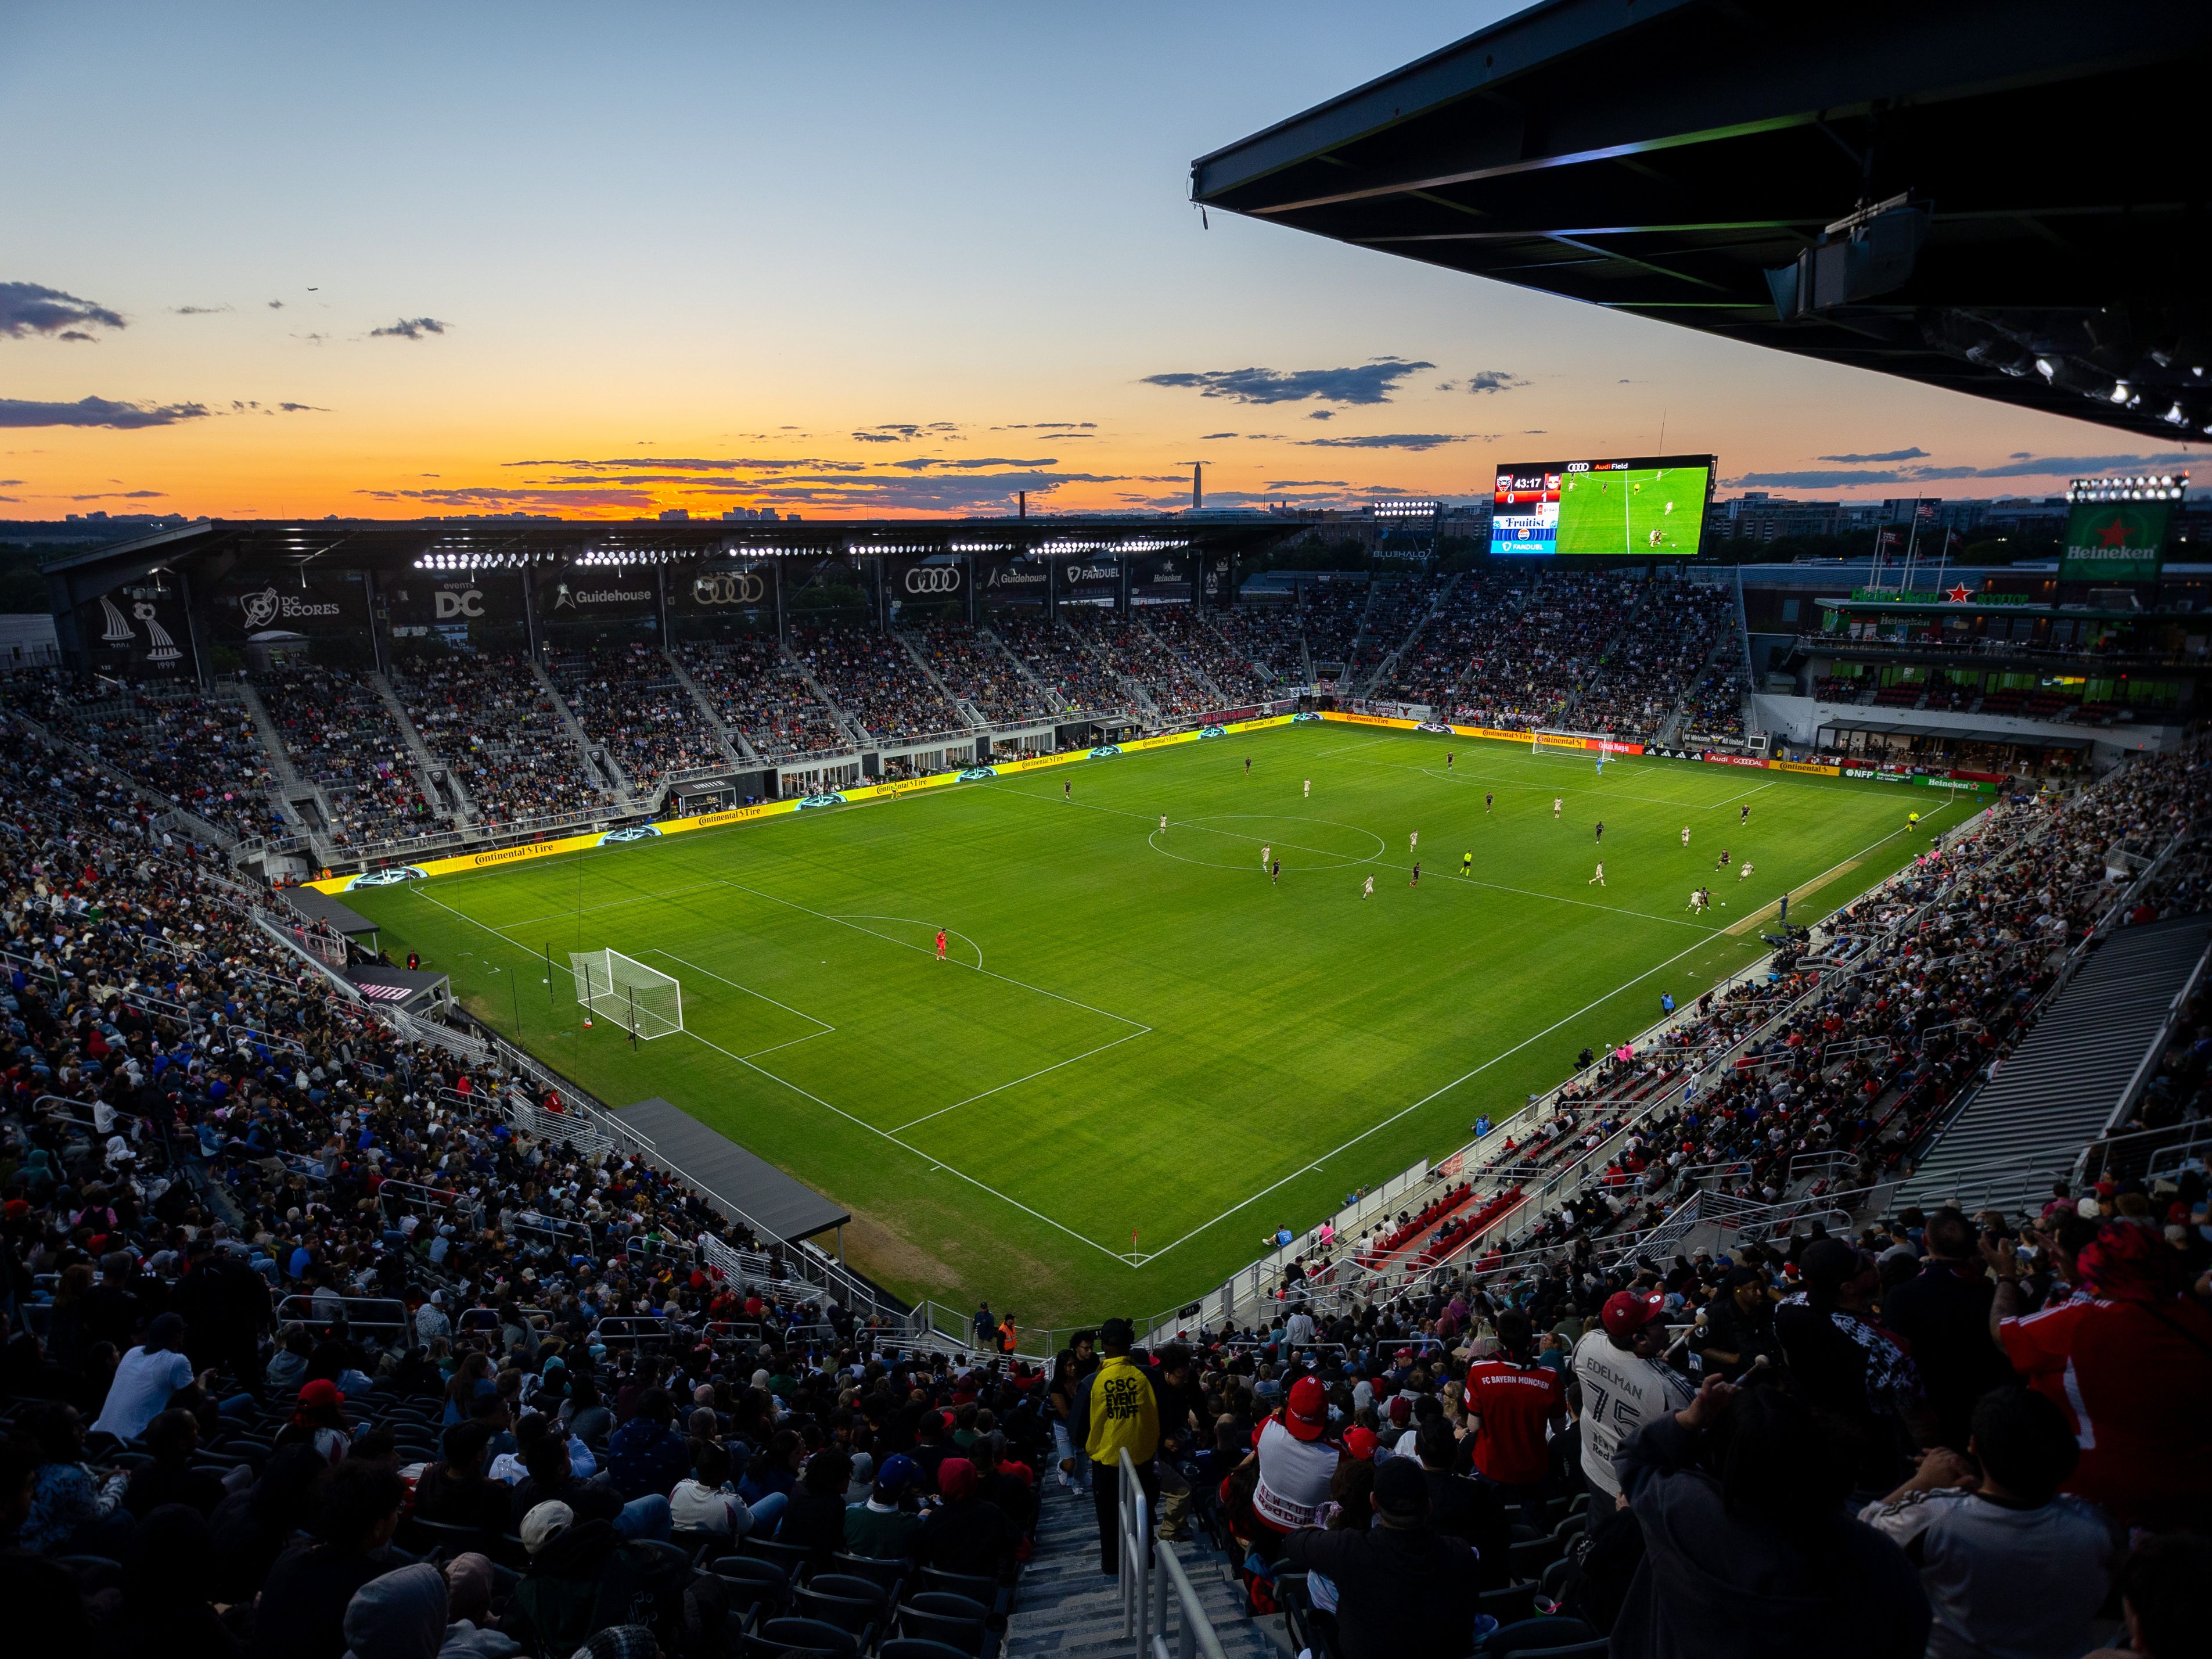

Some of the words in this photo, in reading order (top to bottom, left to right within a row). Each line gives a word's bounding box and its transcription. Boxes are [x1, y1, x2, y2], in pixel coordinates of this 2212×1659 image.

[1515, 478, 1542, 488] 43:17
[1508, 493, 1515, 504] 0
[1542, 492, 1547, 502] 1
[1505, 518, 1545, 527] Fruitist
[1373, 550, 1426, 558] BLUEHALO
[2066, 545, 2155, 559] Heineken
[1001, 573, 1047, 584] Guidehouse
[1082, 567, 1120, 580] FANDUEL
[1153, 573, 1182, 583] Heineken
[444, 581, 475, 590] events
[281, 596, 300, 606] DC
[576, 589, 652, 604] Guidehouse
[1851, 588, 1940, 604] Heineken
[1976, 594, 2030, 605] ROOFTOP
[282, 604, 340, 617] SCORES
[434, 590, 485, 619] DC
[1880, 616, 1932, 627] Heineken
[157, 661, 177, 670] 1999
[1347, 714, 1373, 723] Continental
[1245, 720, 1264, 730] Continental
[1482, 728, 1513, 739] Continental
[1143, 736, 1166, 748] Continental
[1691, 734, 1711, 743] Welcome
[1729, 738, 1744, 746] United
[1022, 757, 1051, 769] Continental
[1053, 755, 1064, 763] Tire
[1779, 762, 1821, 773] Continental
[1854, 770, 1873, 779] NFP
[692, 780, 725, 789] UNITED
[877, 782, 909, 795] Contintal
[913, 778, 927, 787] Tire
[1928, 778, 1969, 790] Heineken
[699, 810, 739, 826] Continental
[743, 807, 761, 817] Tire
[474, 848, 525, 866] Continental
[533, 843, 553, 855] Tire
[1481, 1376, 1491, 1385] FC
[1491, 1376, 1517, 1384] BAYERN
[1587, 1356, 1643, 1401] EDELMAN
[1104, 1377, 1138, 1394] CSC
[1106, 1391, 1138, 1407] EVENT
[1107, 1405, 1139, 1420] STAFF
[1585, 1378, 1641, 1439] 75
[1593, 1442, 1610, 1462] Red
[1260, 1485, 1281, 1506] NEW
[1286, 1502, 1316, 1517] YOR
